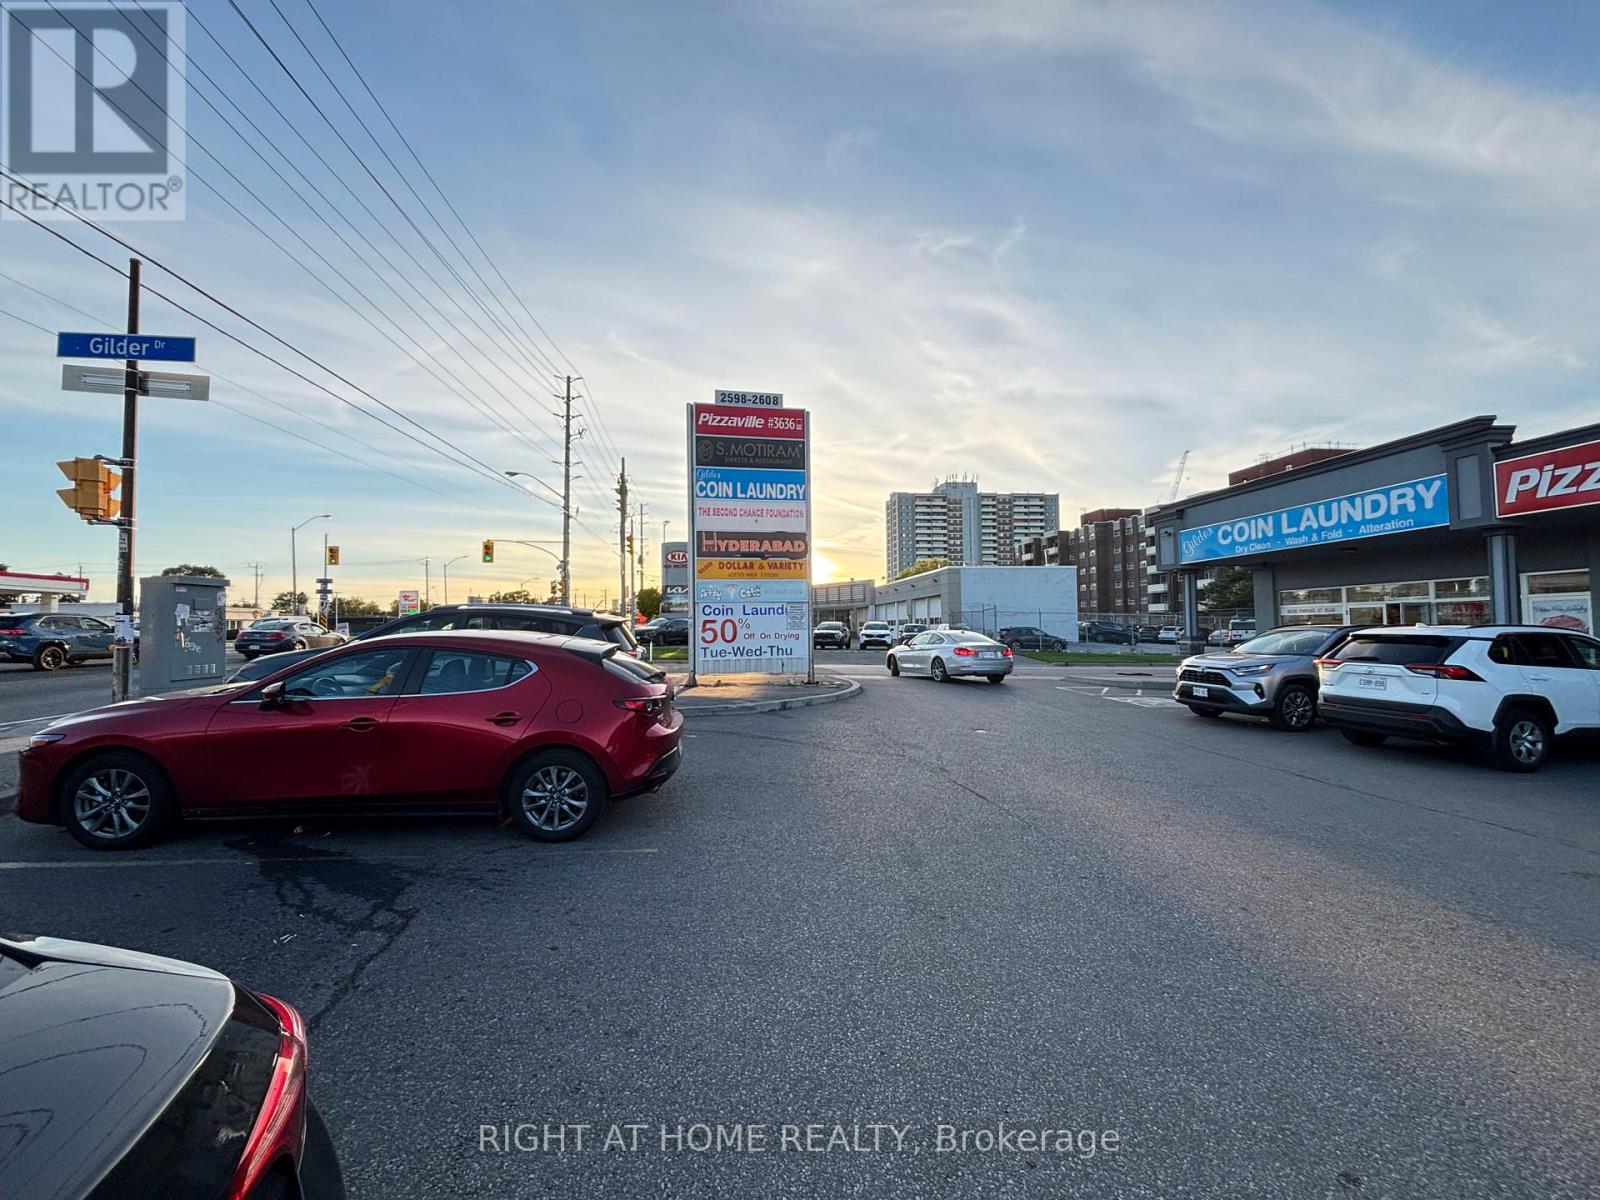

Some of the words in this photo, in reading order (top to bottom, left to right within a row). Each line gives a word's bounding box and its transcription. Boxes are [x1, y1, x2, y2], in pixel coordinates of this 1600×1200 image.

[89, 337, 149, 356] Gilder
[155, 340, 165, 349] Dr
[720, 392, 779, 406] 2598-2608
[698, 412, 764, 428] Pizzaville
[768, 417, 796, 430] #3636
[696, 481, 733, 498] COIN
[737, 482, 805, 499] LAUNDRY
[698, 507, 711, 517] THE
[712, 507, 738, 517] SECOND
[740, 508, 764, 518] CHANCE
[766, 508, 804, 519] FOUNDATION
[1217, 515, 1273, 545] COIN
[1281, 480, 1441, 535] LAUNDRY
[702, 531, 805, 552] HYDERABAD
[1235, 545, 1248, 554] Dry
[1249, 542, 1271, 552] Clean
[1285, 535, 1308, 546] Wash
[1311, 534, 1318, 542] &
[1321, 529, 1343, 540] Fold
[1359, 518, 1414, 535] Alteration
[718, 561, 754, 570] DOLLAR
[758, 562, 765, 570] &
[768, 561, 804, 571] VARIETY
[702, 605, 733, 616] Coin
[744, 632, 755, 640] Off
[760, 632, 771, 640] On
[774, 632, 800, 641] Drying
[700, 645, 793, 658] Tue-Wed-Thu
